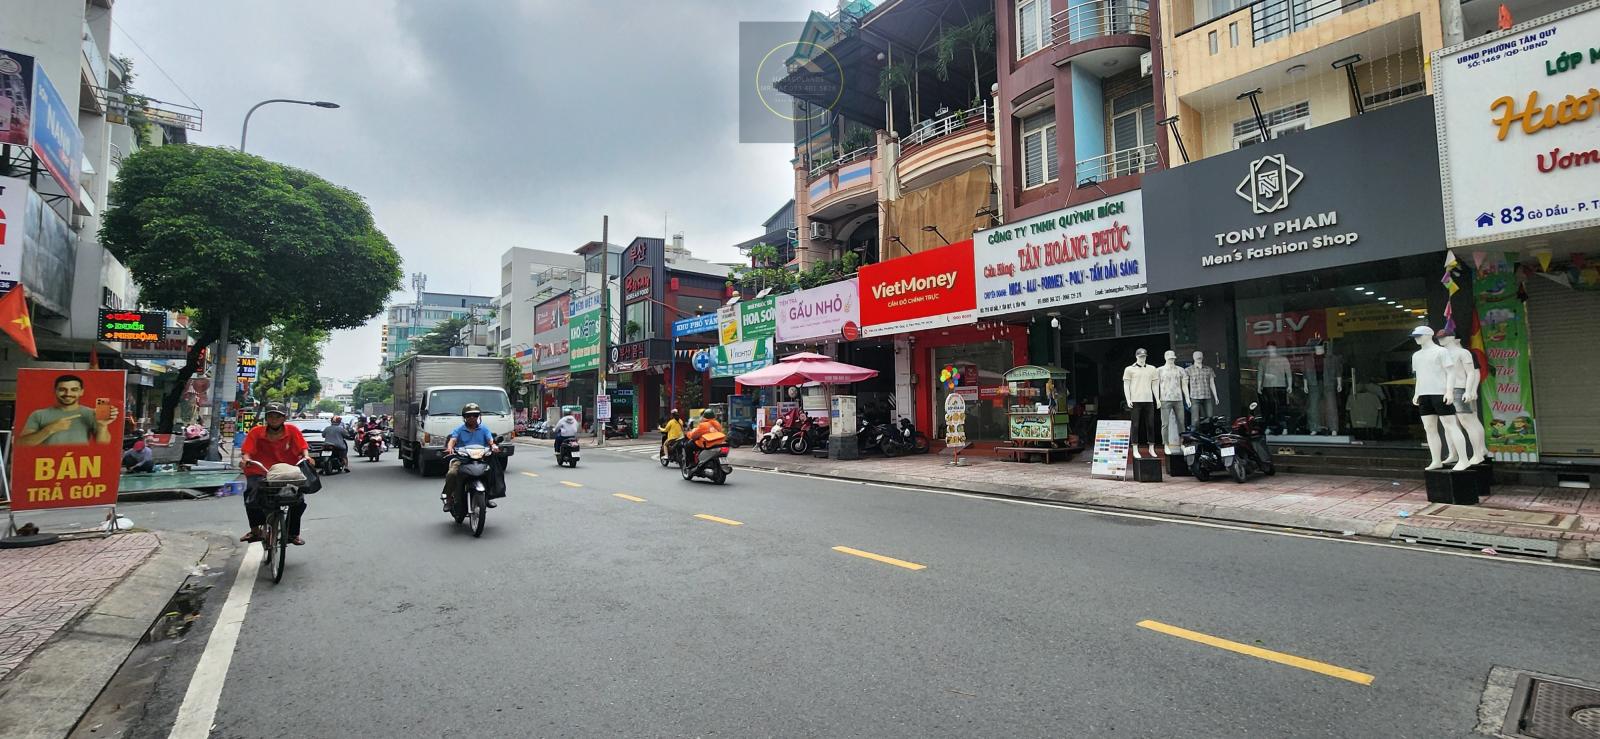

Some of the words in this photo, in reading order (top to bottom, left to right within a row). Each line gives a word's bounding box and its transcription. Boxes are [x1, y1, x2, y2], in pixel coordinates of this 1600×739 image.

[1457, 54, 1480, 65] UBND
[1482, 54, 1502, 66] 1469
[1545, 51, 1583, 76] LỚP
[1501, 206, 1526, 225] 83
[1528, 210, 1543, 220] Gò
[1578, 202, 1589, 212] P.
[987, 228, 1013, 245] CÔNG
[1013, 226, 1028, 239] TY
[1030, 218, 1057, 234] TNHH
[1215, 225, 1267, 246] TONY
[1274, 211, 1337, 236] PHAM
[630, 242, 648, 264] 부산
[1018, 242, 1043, 272] TÂN
[1044, 233, 1090, 267] HOÀNG
[1092, 220, 1132, 257] PHÚC
[1247, 241, 1308, 260] Fashion
[1312, 231, 1359, 249] Shop
[871, 271, 957, 300] VietMoney
[743, 311, 760, 326] HOA
[789, 301, 812, 320] GẤU
[815, 294, 842, 315] NHỎ
[34, 451, 102, 480] BÁN
[27, 482, 64, 501] TRẢ
[69, 482, 107, 498] GÓP
